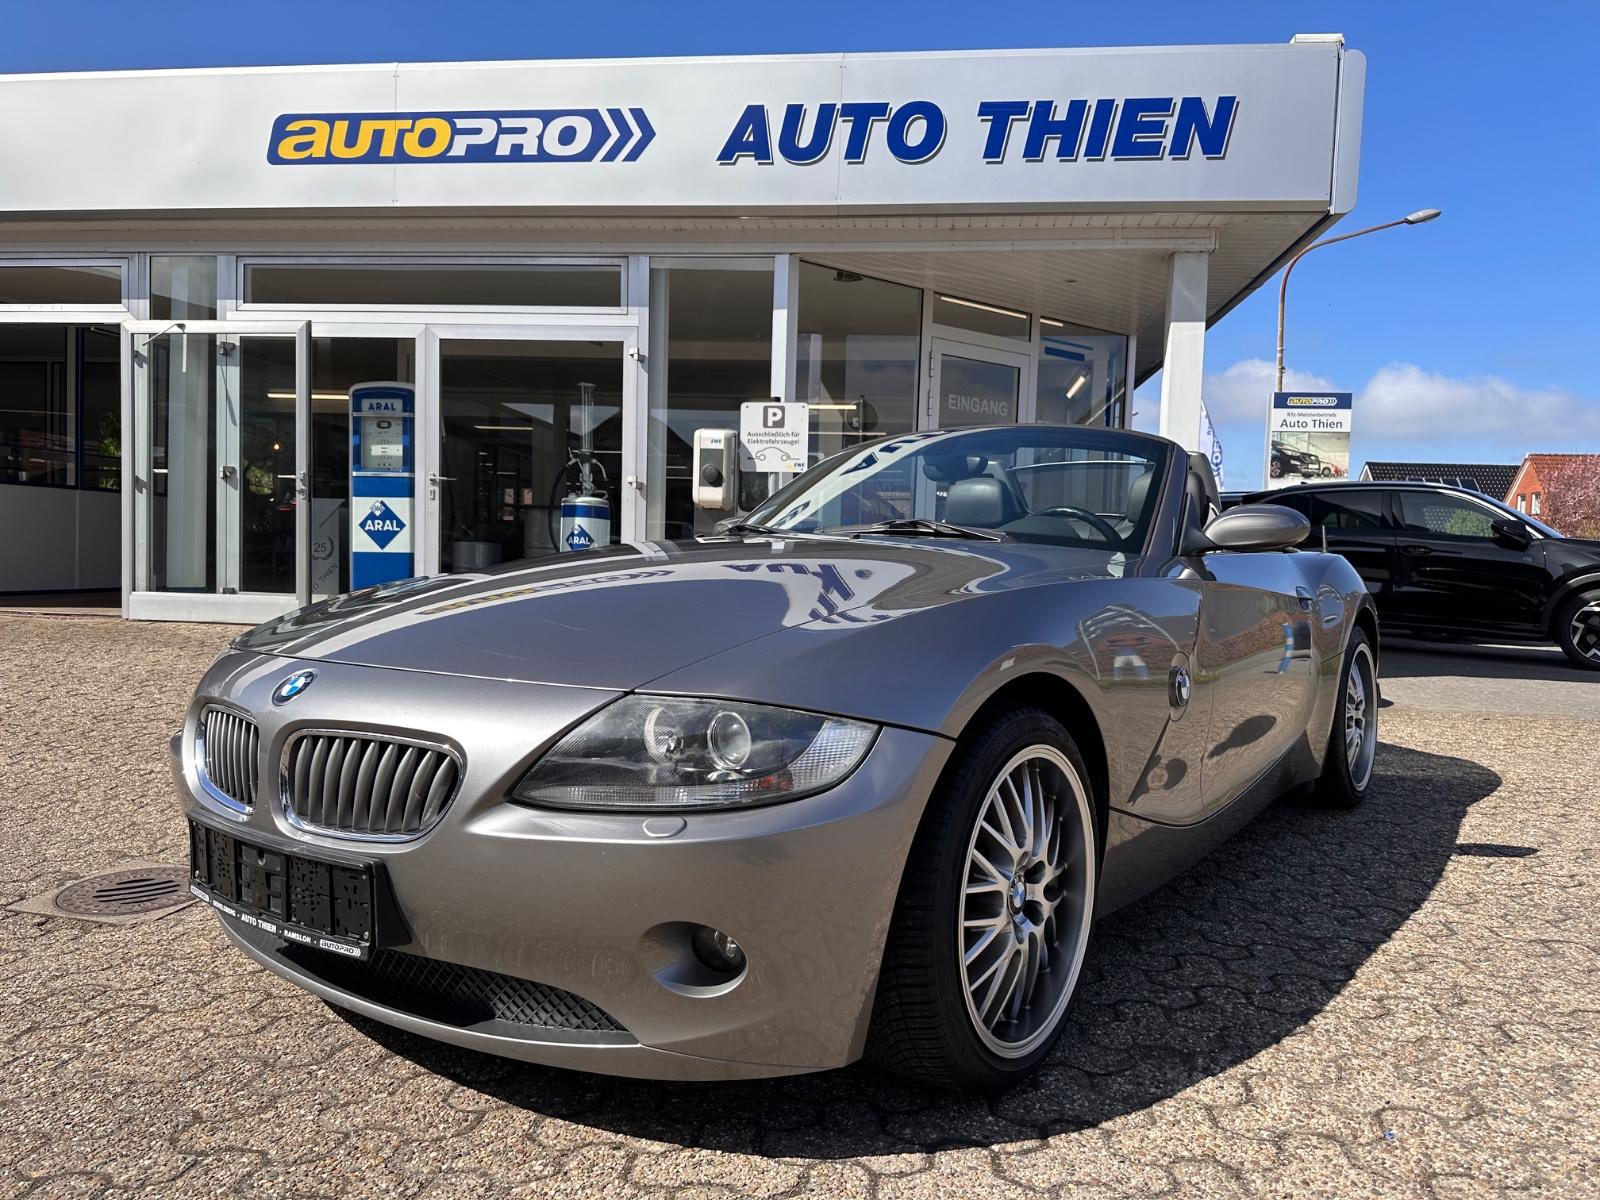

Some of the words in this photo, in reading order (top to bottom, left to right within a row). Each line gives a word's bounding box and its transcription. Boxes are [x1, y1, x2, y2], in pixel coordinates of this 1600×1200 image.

[717, 99, 947, 165] AUTO
[977, 95, 1239, 163] THIEN
[368, 402, 397, 411] ARAL
[948, 394, 1008, 417] EINGANG
[767, 407, 783, 427] P
[1279, 419, 1308, 429] Auto
[1311, 419, 1343, 429] Thien
[364, 519, 401, 531] ARAL
[568, 536, 591, 545] ARAL
[241, 913, 257, 926] AUTO
[258, 919, 277, 934] THIEN
